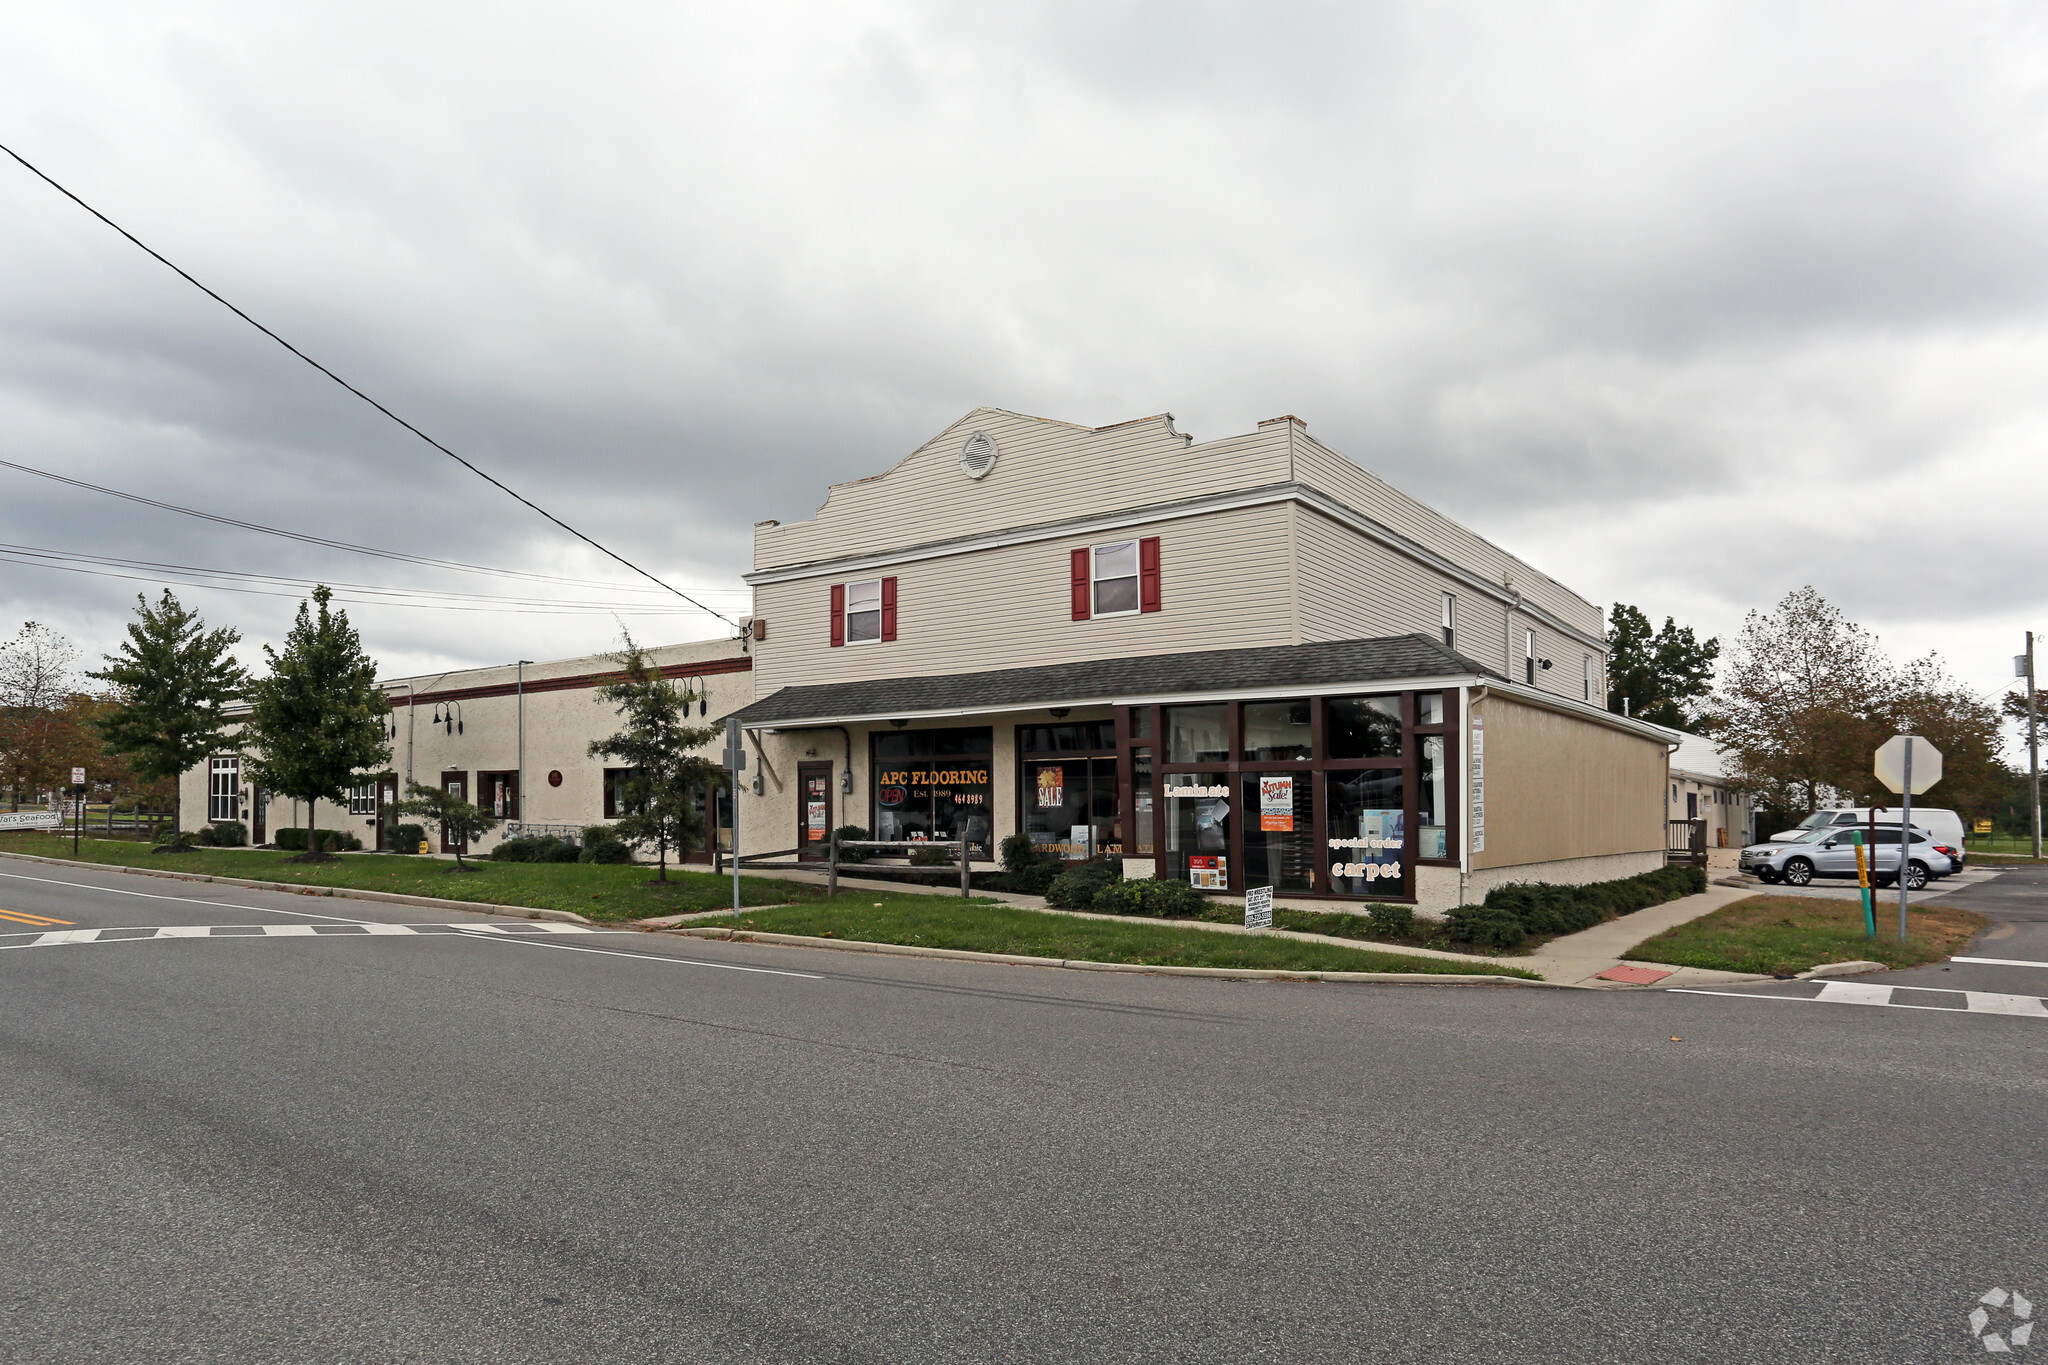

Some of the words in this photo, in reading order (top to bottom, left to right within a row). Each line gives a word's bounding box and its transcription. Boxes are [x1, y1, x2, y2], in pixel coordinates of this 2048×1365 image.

[880, 772, 908, 785] APC
[912, 770, 988, 785] FLOORING
[934, 789, 951, 798] 1989
[1164, 784, 1230, 797] Laminate
[1262, 780, 1291, 796] AUTUMN
[880, 789, 905, 802] OPEN
[1038, 787, 1062, 806] SALE
[1267, 790, 1288, 802] Sale!
[20, 813, 56, 823] Seafood
[1034, 843, 1085, 854] ARDWOOD
[1328, 837, 1368, 849] special
[1370, 838, 1402, 849] order
[1332, 860, 1401, 882] carpet
